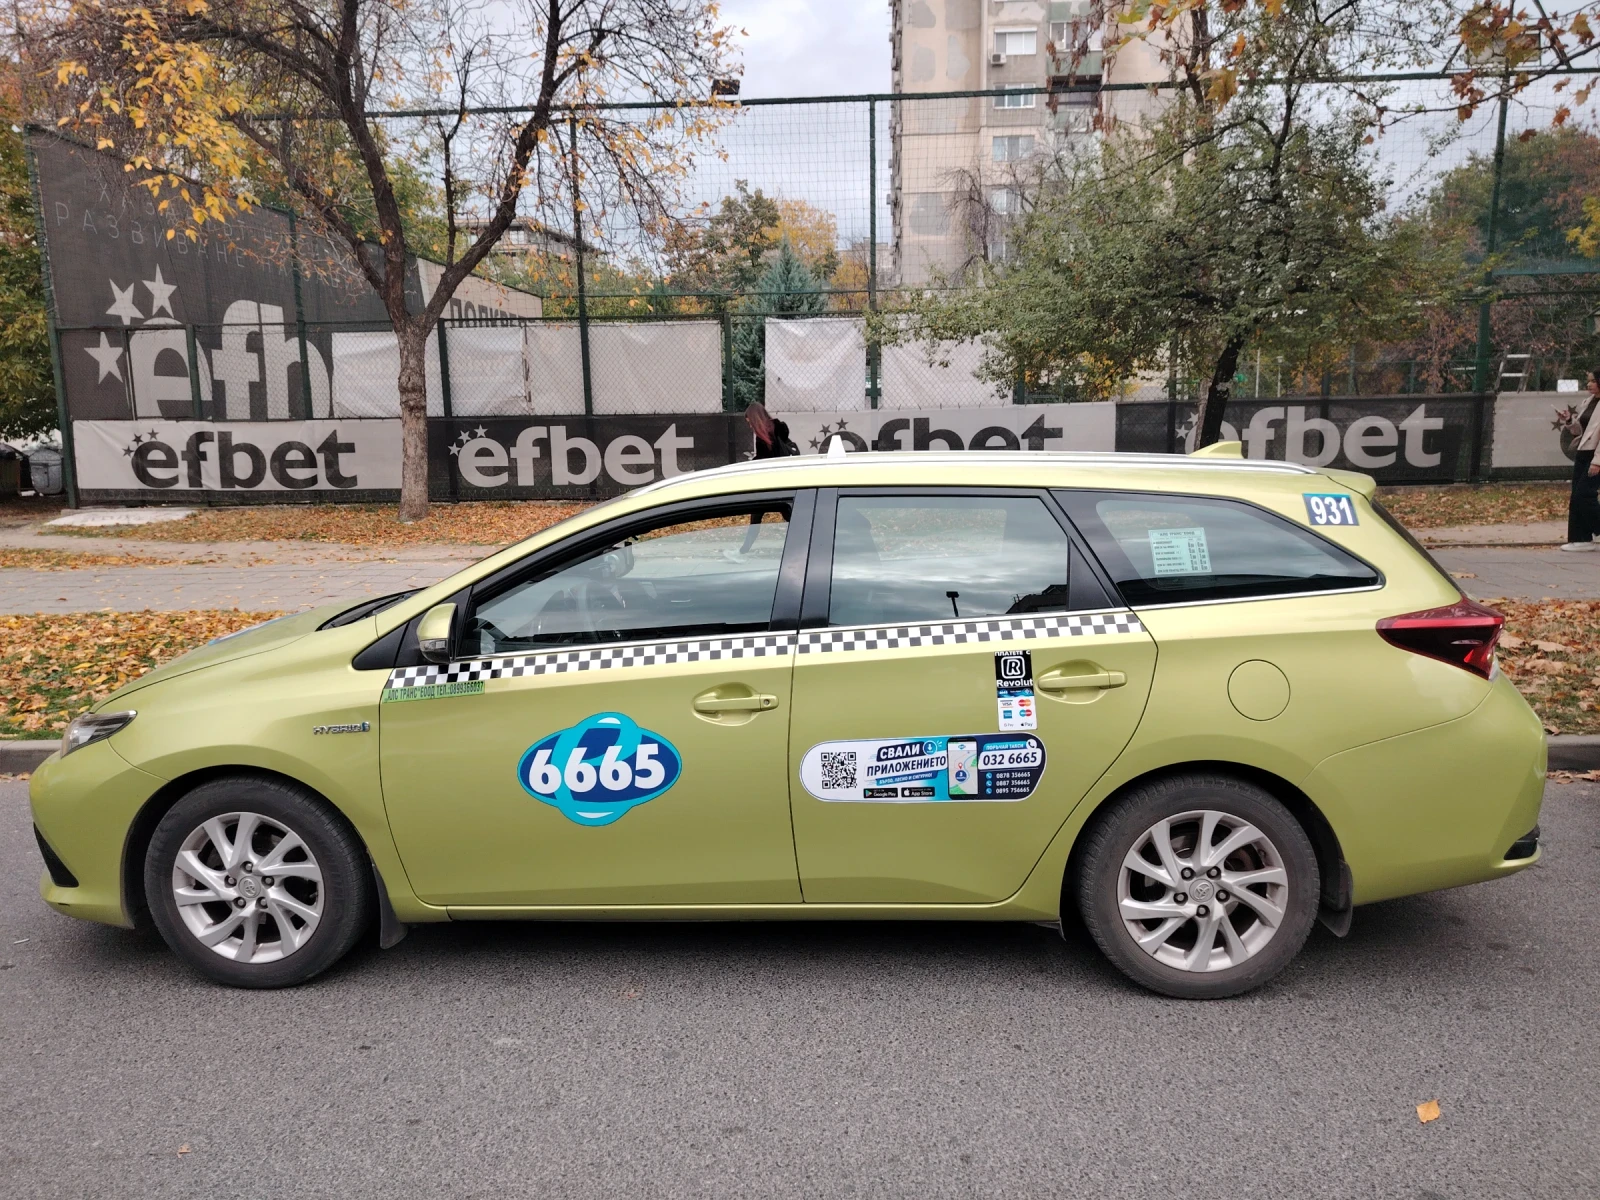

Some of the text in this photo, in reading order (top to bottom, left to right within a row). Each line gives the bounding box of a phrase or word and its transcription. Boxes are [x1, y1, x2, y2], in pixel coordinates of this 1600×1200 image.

[55, 202, 245, 268] РАЗВИВАНЕ
[131, 429, 358, 489] efbet
[458, 423, 694, 487] efbet
[1310, 496, 1354, 525] 931
[997, 679, 1033, 687] Revolut
[313, 723, 361, 735] HYBRID
[880, 743, 920, 759] СВАЛИ
[983, 751, 1037, 766] 032 6665
[529, 744, 666, 794] 6665
[867, 756, 946, 777] ПРИЛОЖЕНИЕТО
